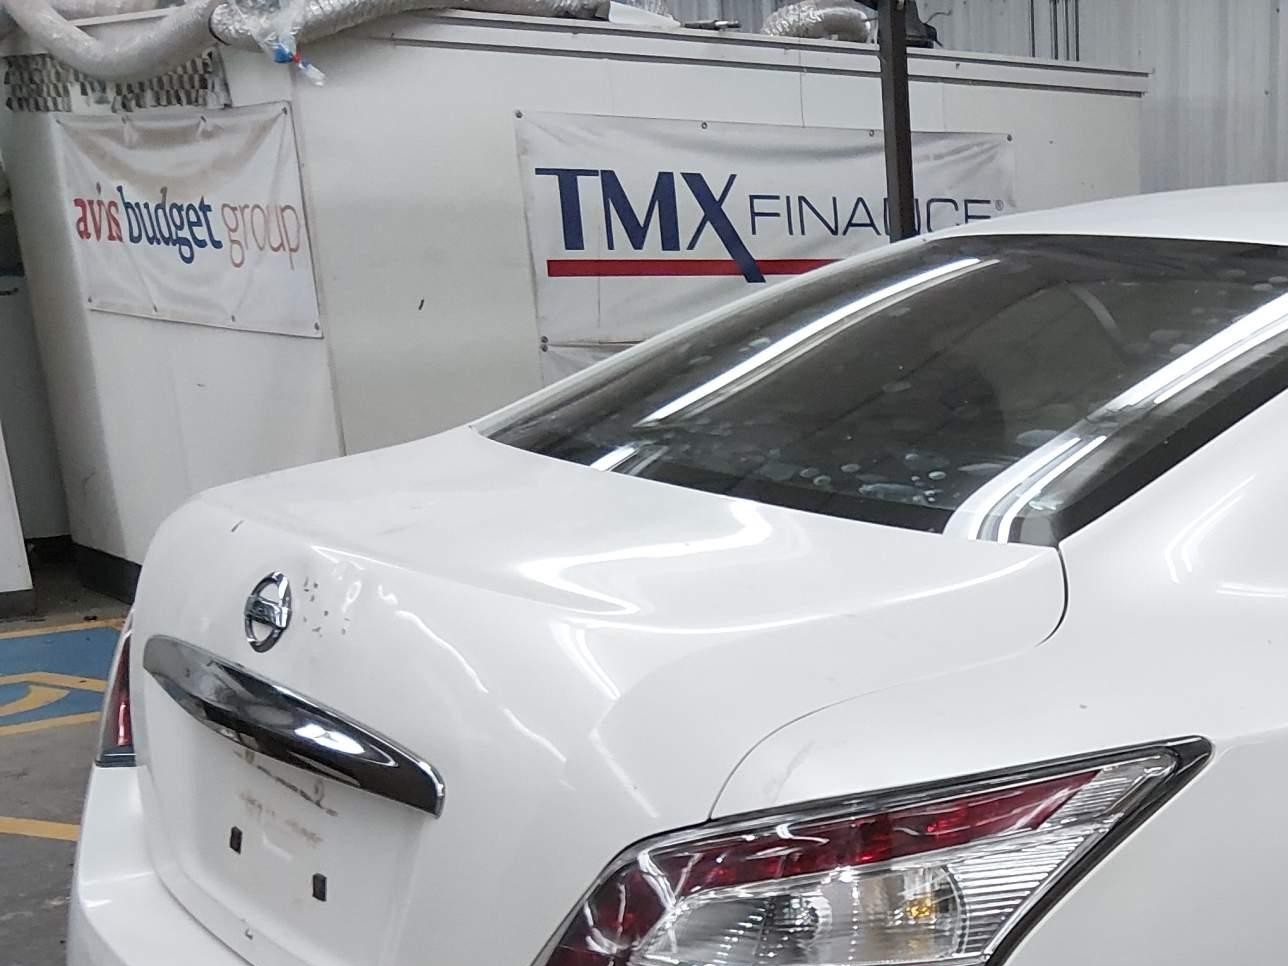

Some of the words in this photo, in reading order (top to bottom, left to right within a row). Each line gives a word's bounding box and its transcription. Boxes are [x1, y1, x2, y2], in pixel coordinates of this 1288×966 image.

[73, 182, 125, 243] avis
[116, 185, 224, 265] budget
[221, 202, 301, 270] group
[535, 167, 766, 283] TMX
